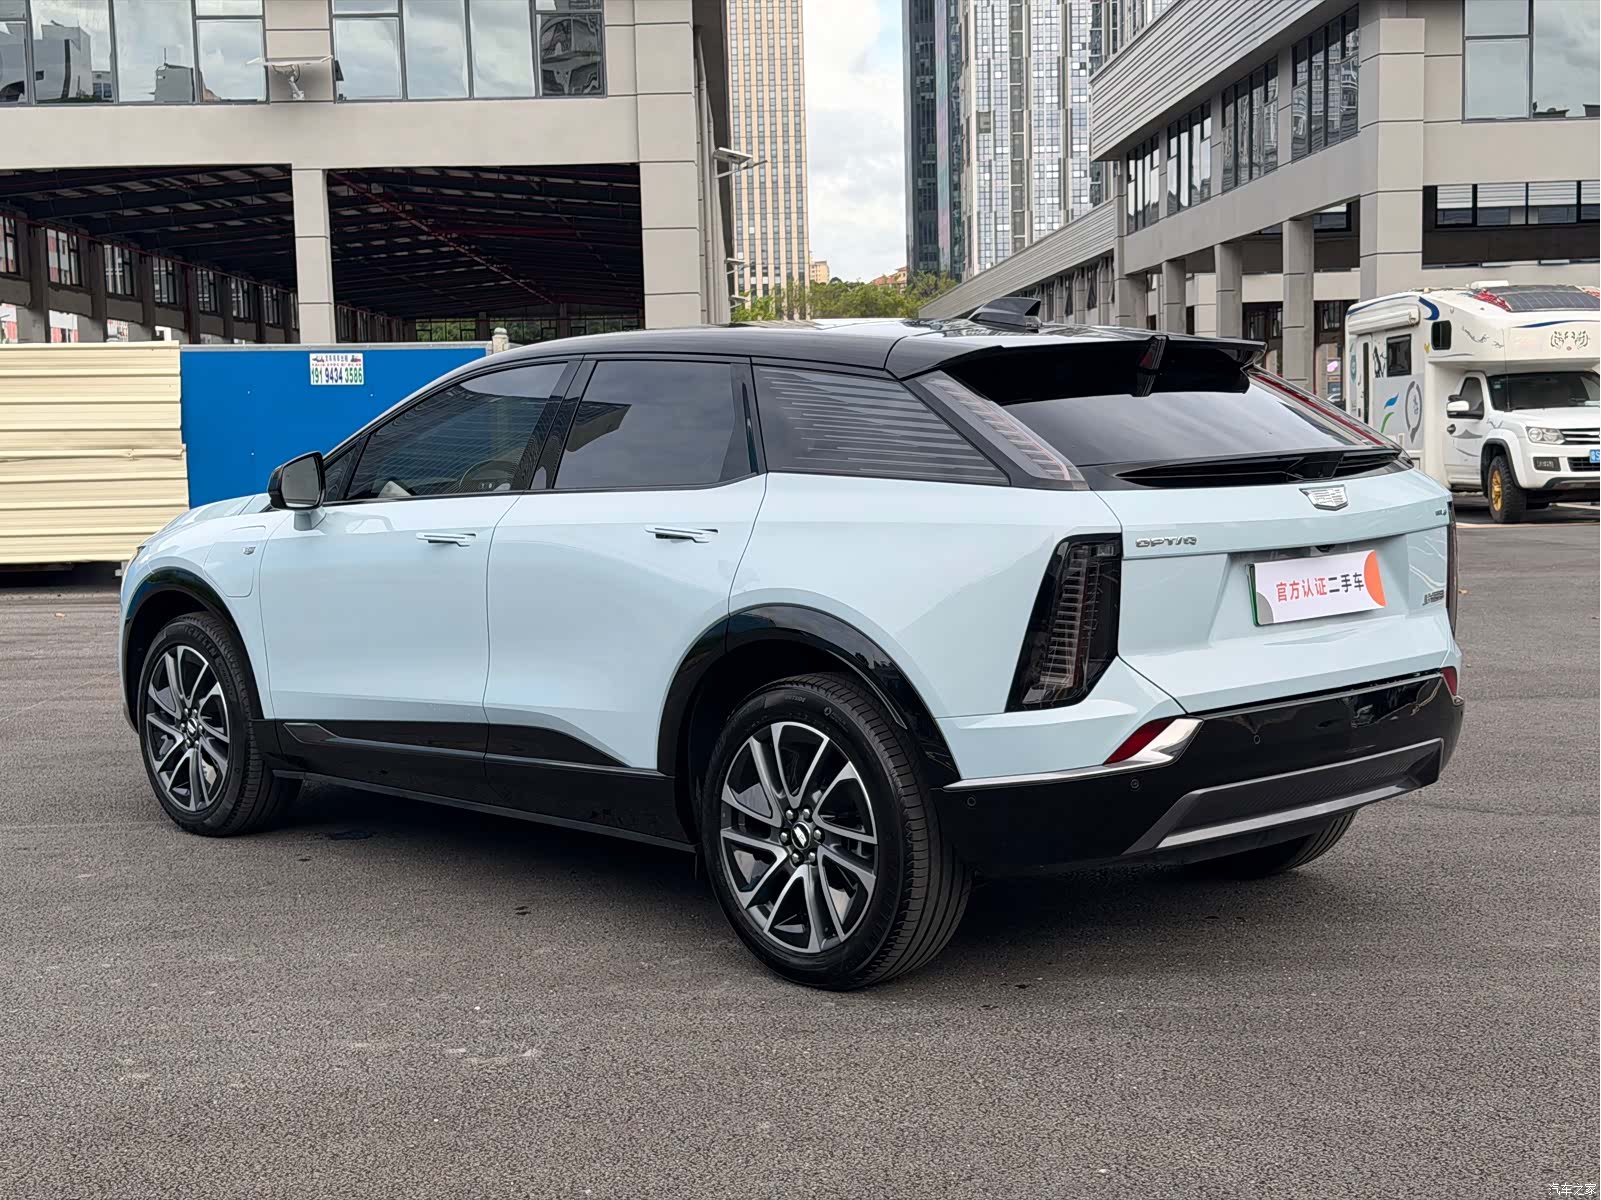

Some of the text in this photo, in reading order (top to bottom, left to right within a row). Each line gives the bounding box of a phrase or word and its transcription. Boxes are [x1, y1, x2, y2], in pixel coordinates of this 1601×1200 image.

[312, 367, 363, 384] 191 9434 3586
[1135, 536, 1198, 548] OPTIQ
[1276, 572, 1365, 603] 官方认证二手车
